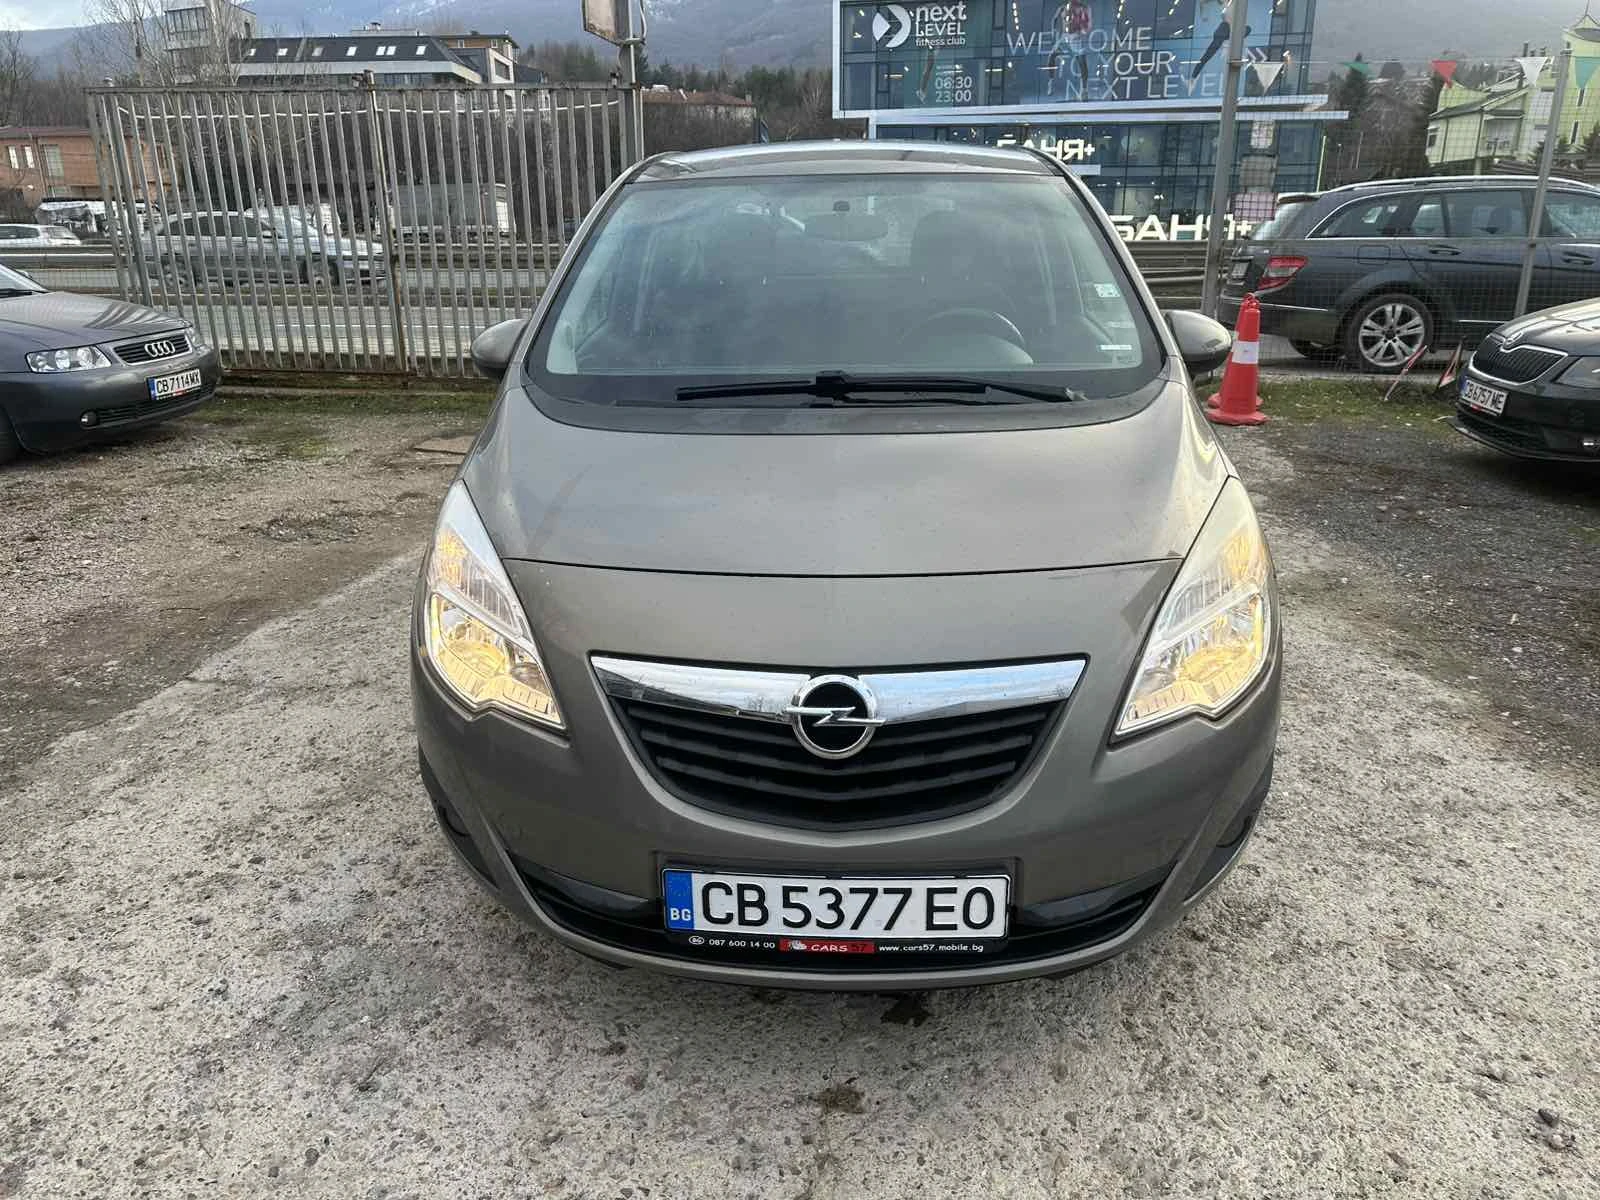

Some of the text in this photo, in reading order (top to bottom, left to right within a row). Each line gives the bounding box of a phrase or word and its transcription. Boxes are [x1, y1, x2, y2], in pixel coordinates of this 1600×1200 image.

[915, 1, 967, 21] next
[915, 21, 966, 37] LEVEL
[915, 37, 966, 47] fitness club
[1098, 51, 1174, 76] YOUR
[1065, 76, 1138, 101] NEXT
[670, 908, 692, 922] BG
[702, 881, 769, 927] CB
[782, 884, 913, 931] 5377
[811, 944, 848, 953] CARS
[879, 944, 984, 953] www.cars57.mobile.bg
